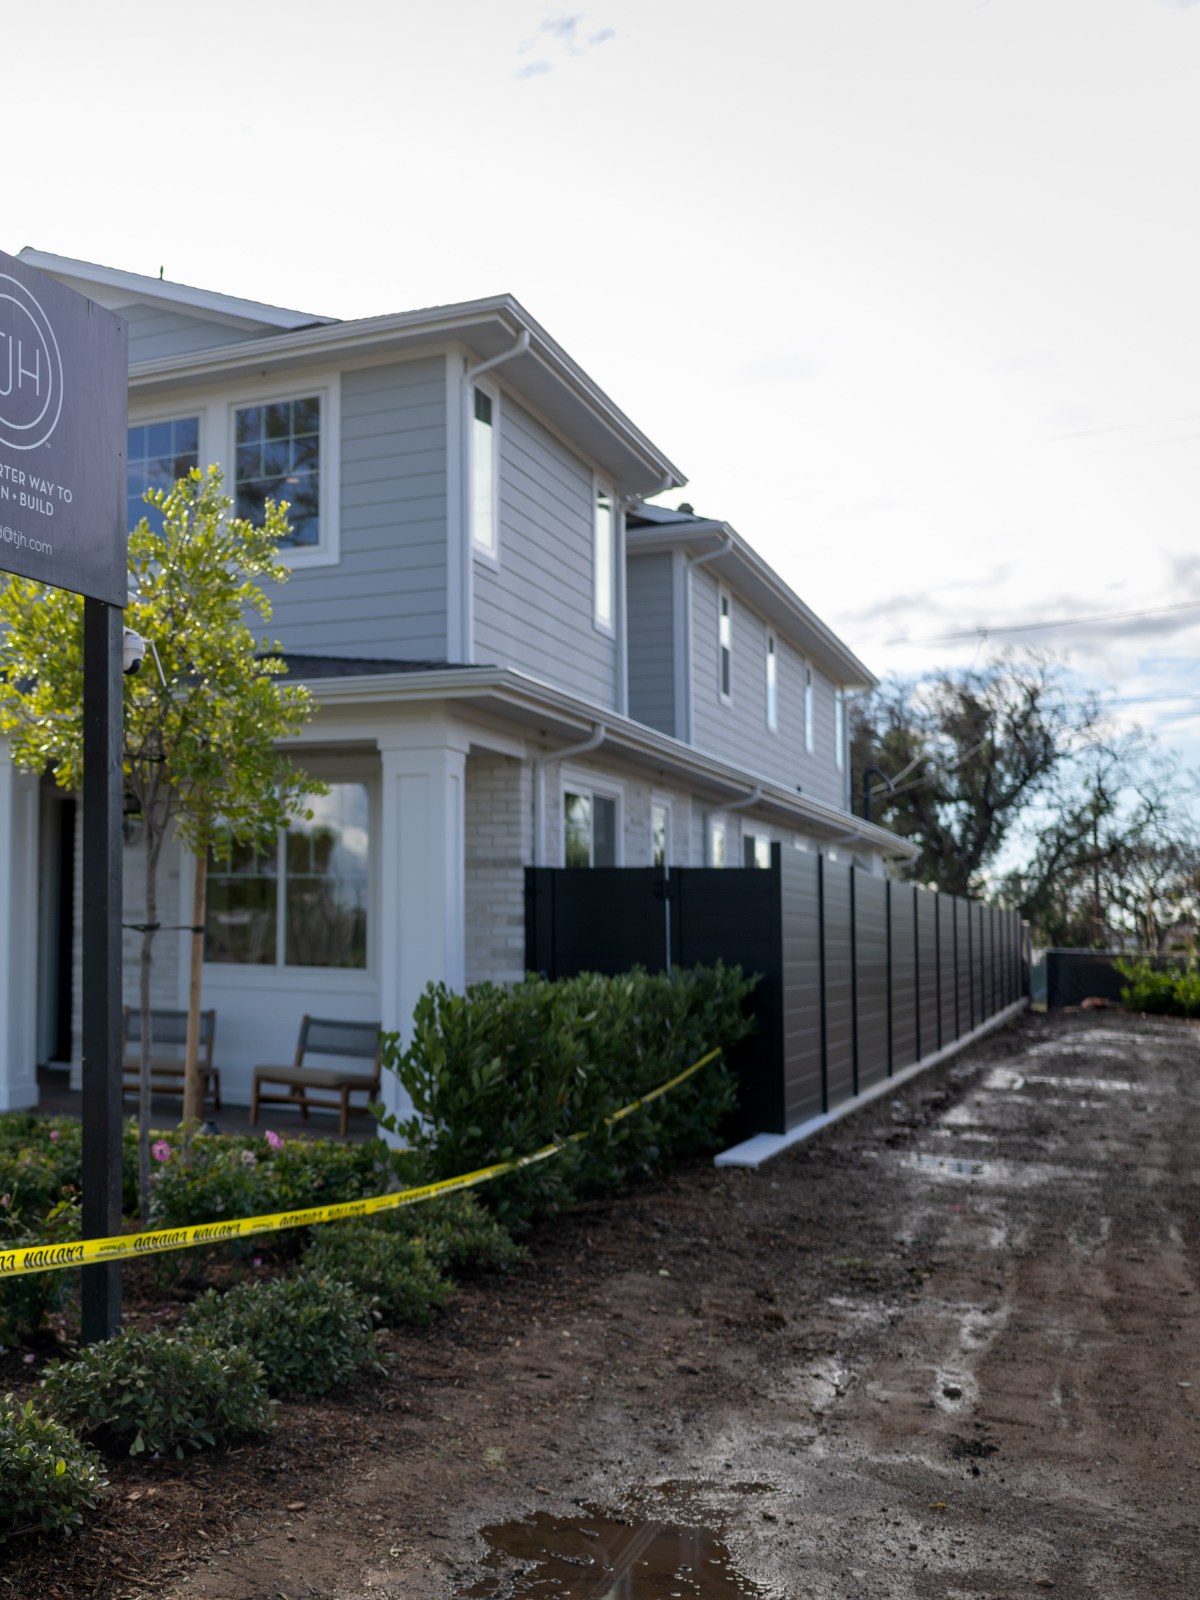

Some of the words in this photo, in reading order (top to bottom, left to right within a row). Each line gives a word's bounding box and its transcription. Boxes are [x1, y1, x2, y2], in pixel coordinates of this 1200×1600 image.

[28, 474, 55, 496] WAY
[57, 485, 73, 503] TO
[19, 492, 54, 516] BUILD
[134, 1231, 187, 1252] CUIDADO
[23, 1245, 84, 1269] CAUTION
